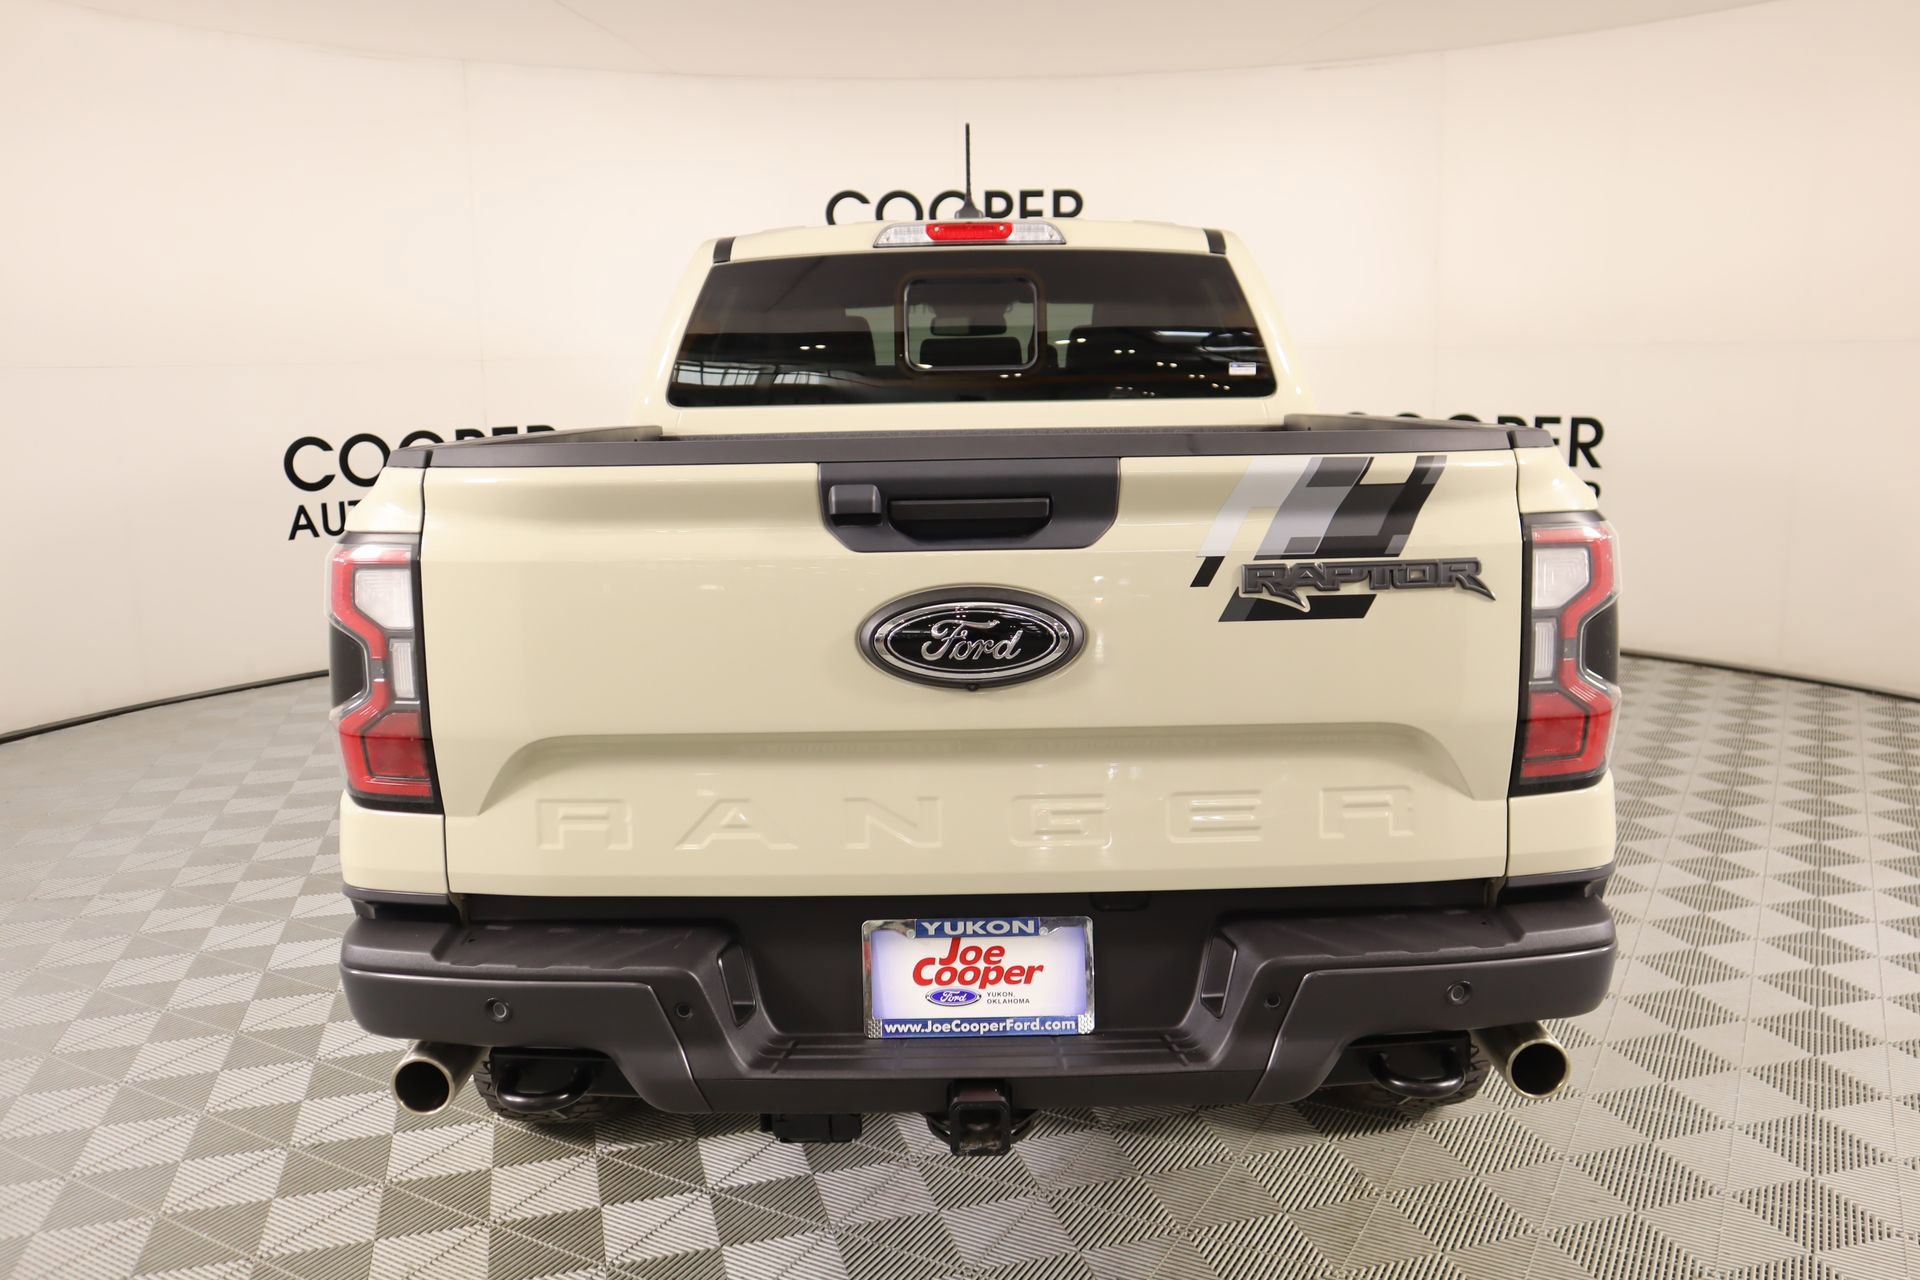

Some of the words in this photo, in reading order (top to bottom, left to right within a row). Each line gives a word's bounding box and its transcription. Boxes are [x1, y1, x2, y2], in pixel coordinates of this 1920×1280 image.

[1238, 557, 1496, 608] RAPTOR
[921, 619, 1023, 661] Ford
[536, 785, 1416, 851] RANGER
[921, 919, 1036, 936] YUKON
[939, 937, 1006, 966] Joe
[912, 957, 1044, 990] Cooper
[939, 990, 968, 1002] Ford
[885, 1017, 1077, 1035] www.JoeCooperFord.com
